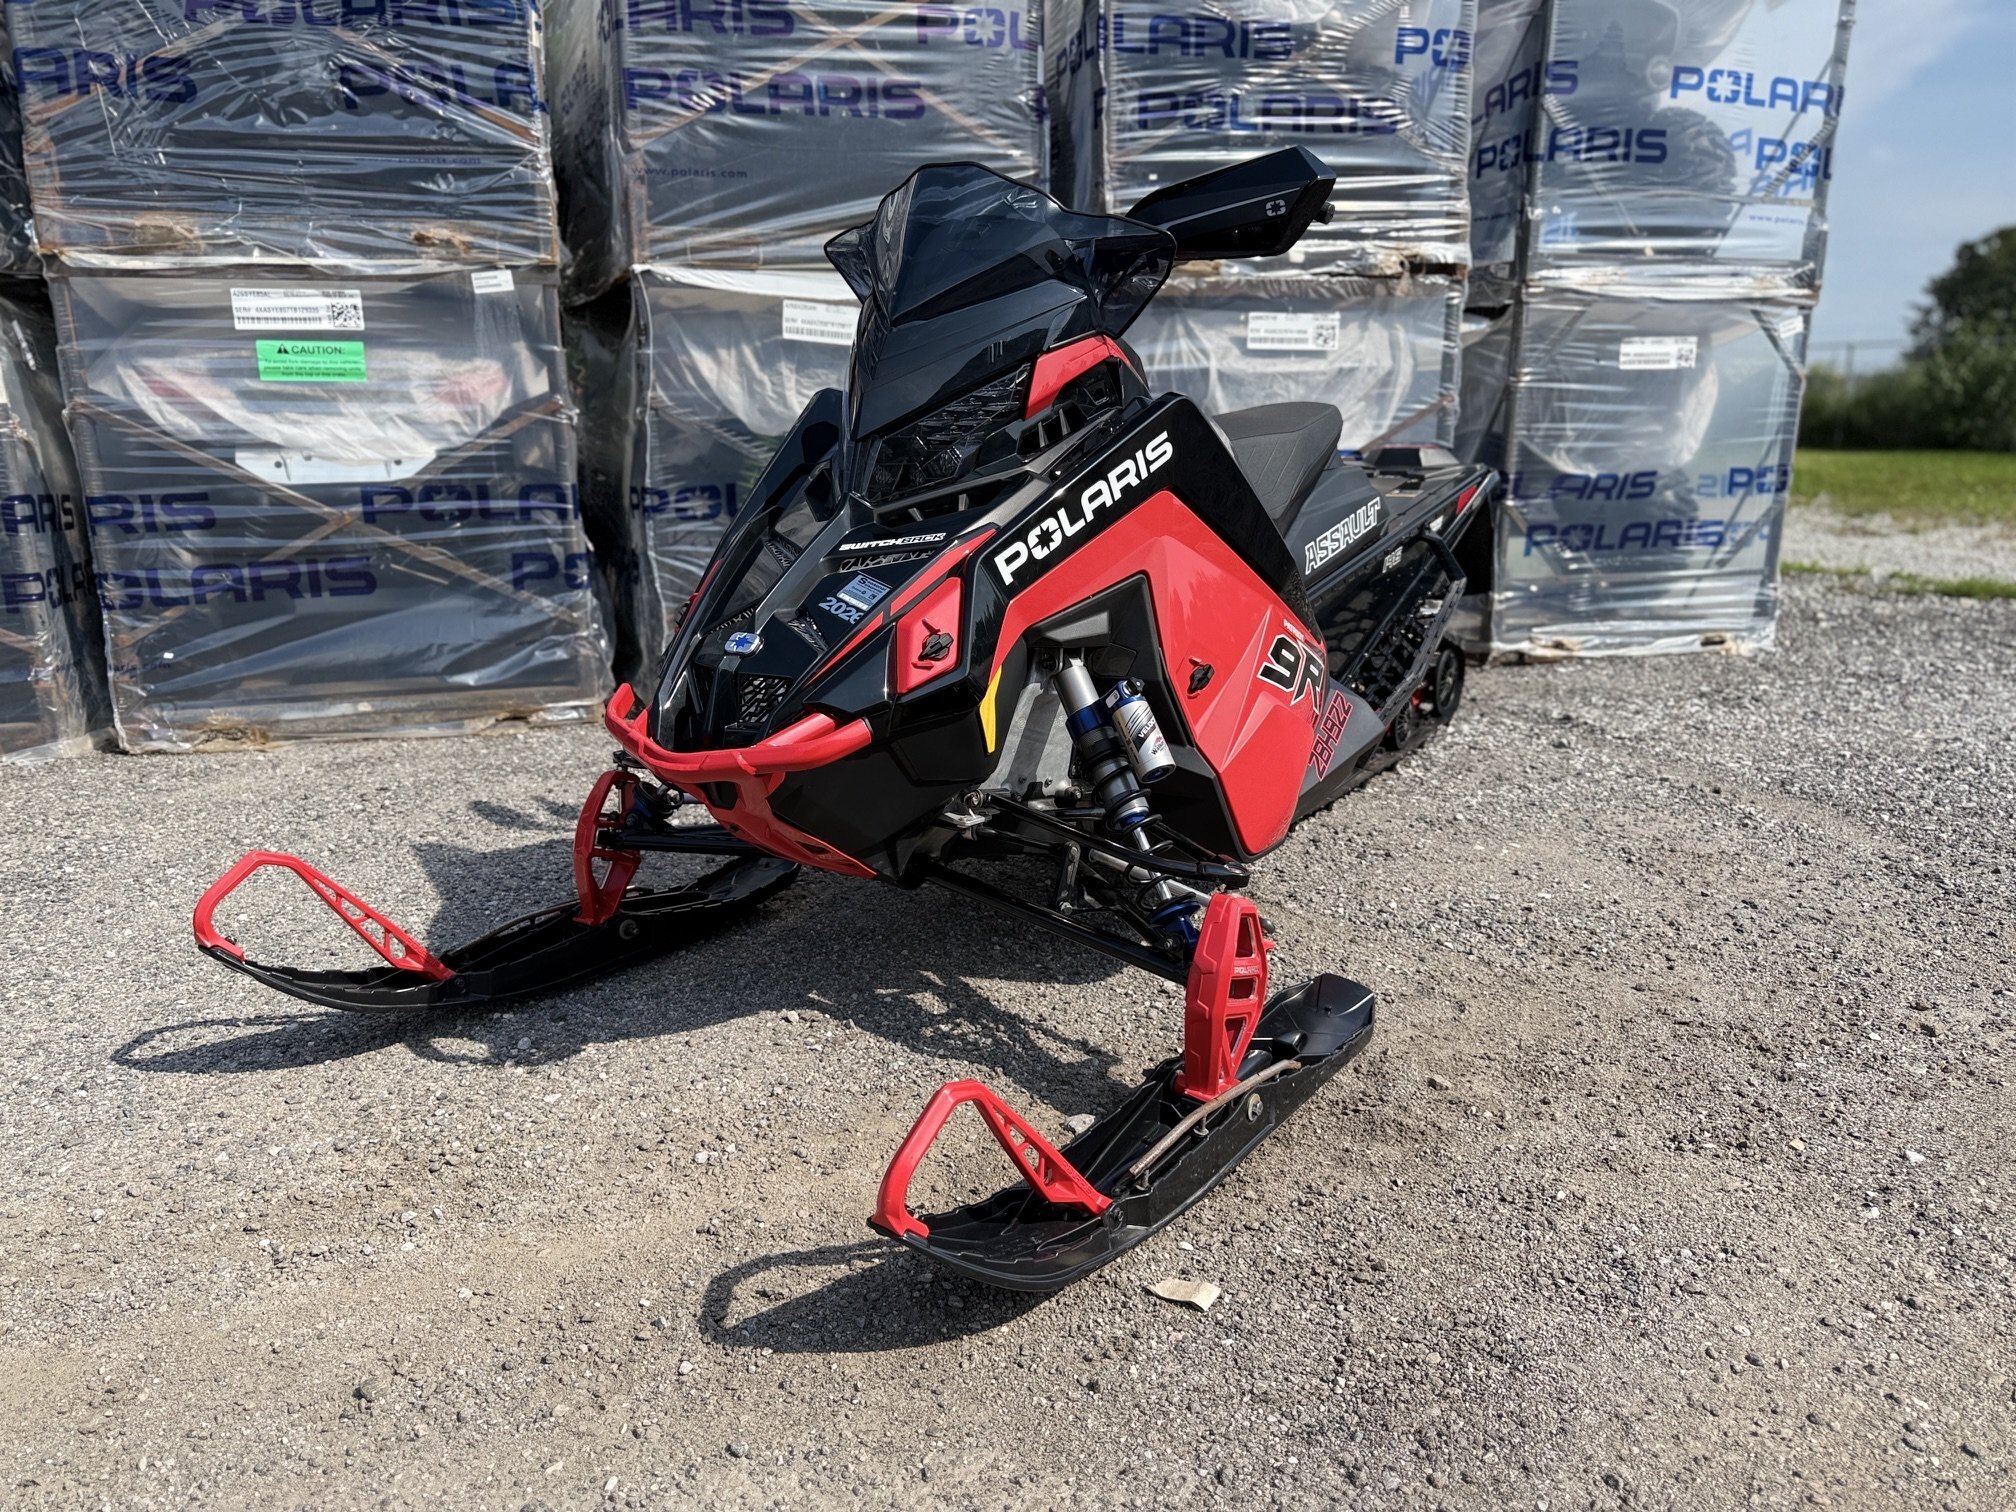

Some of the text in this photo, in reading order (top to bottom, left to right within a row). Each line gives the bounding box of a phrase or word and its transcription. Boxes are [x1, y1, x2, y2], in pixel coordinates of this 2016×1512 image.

[622, 67, 925, 119] POLARIS
[1476, 127, 1668, 180] POLARIS
[994, 430, 1173, 586] POLARIS
[1305, 496, 1381, 575] ASSAULT
[1523, 518, 1724, 557] POLARIS
